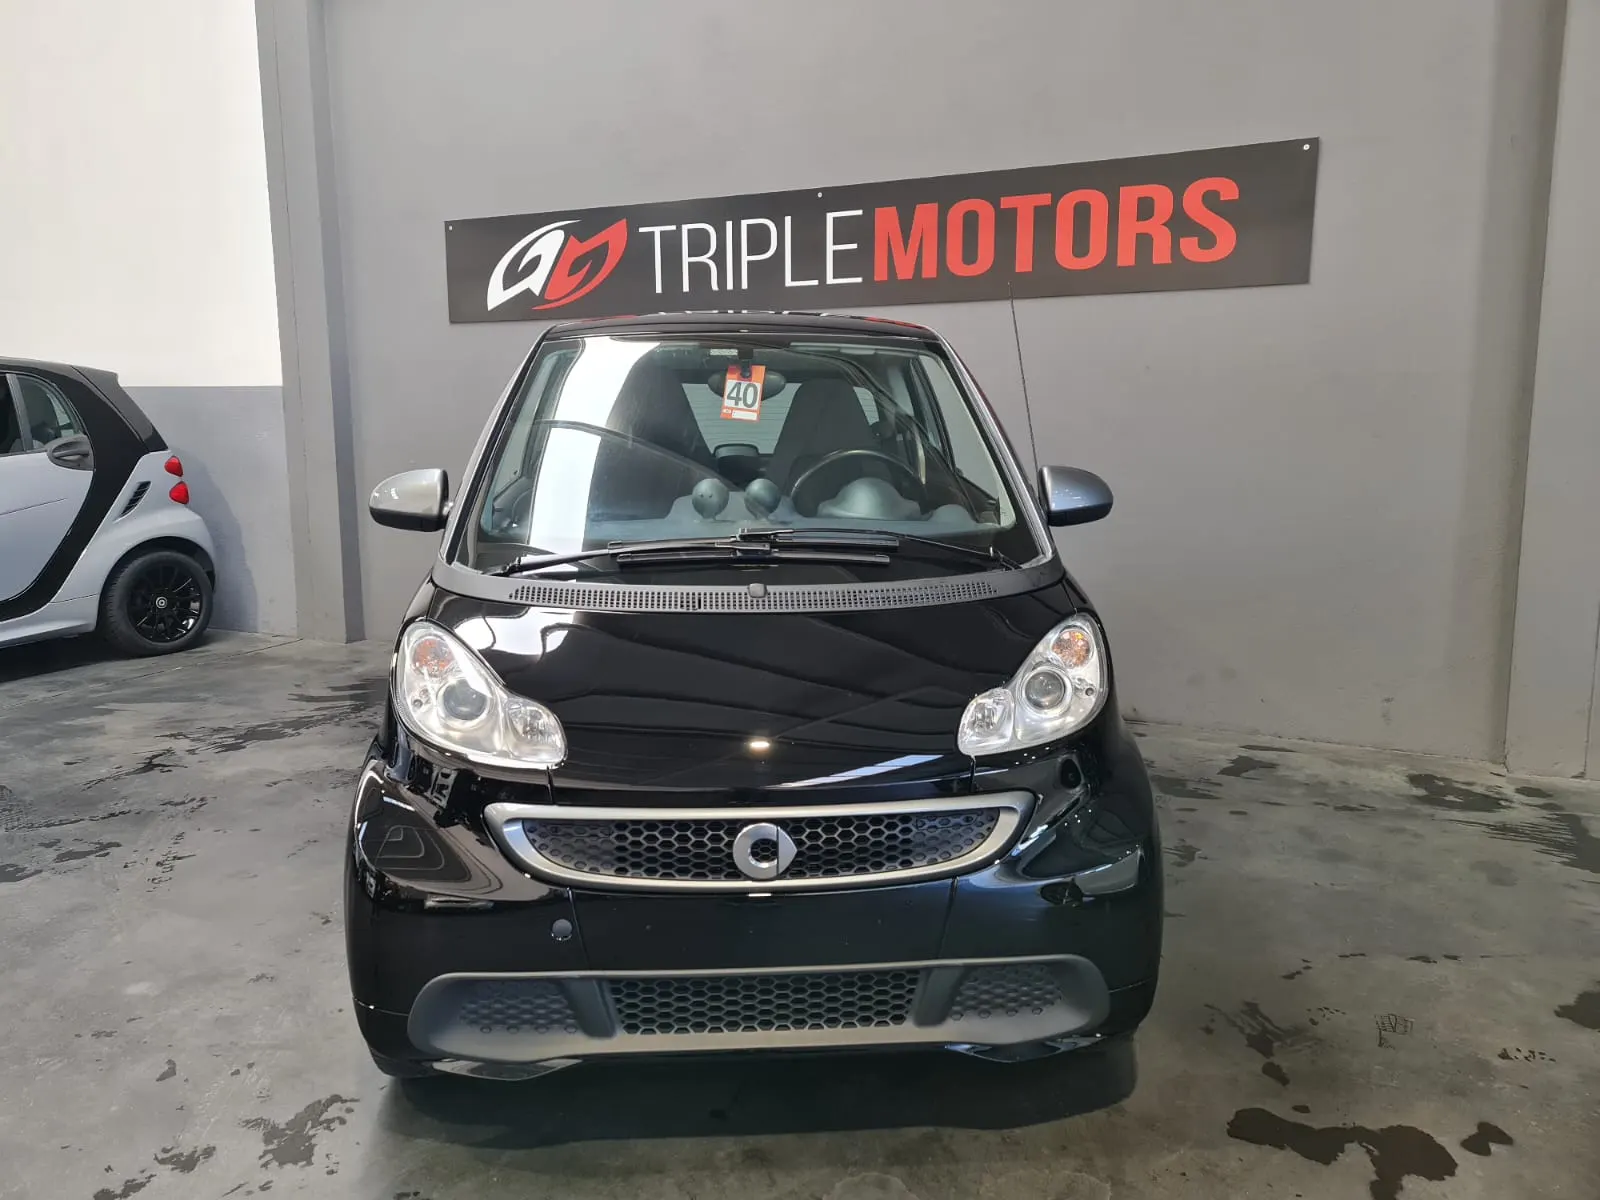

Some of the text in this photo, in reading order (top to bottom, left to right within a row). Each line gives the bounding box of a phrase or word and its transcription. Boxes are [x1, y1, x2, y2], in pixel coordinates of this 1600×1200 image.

[638, 209, 864, 294] TRIPLE
[873, 176, 1240, 282] MOTORS
[726, 382, 758, 409] 40
